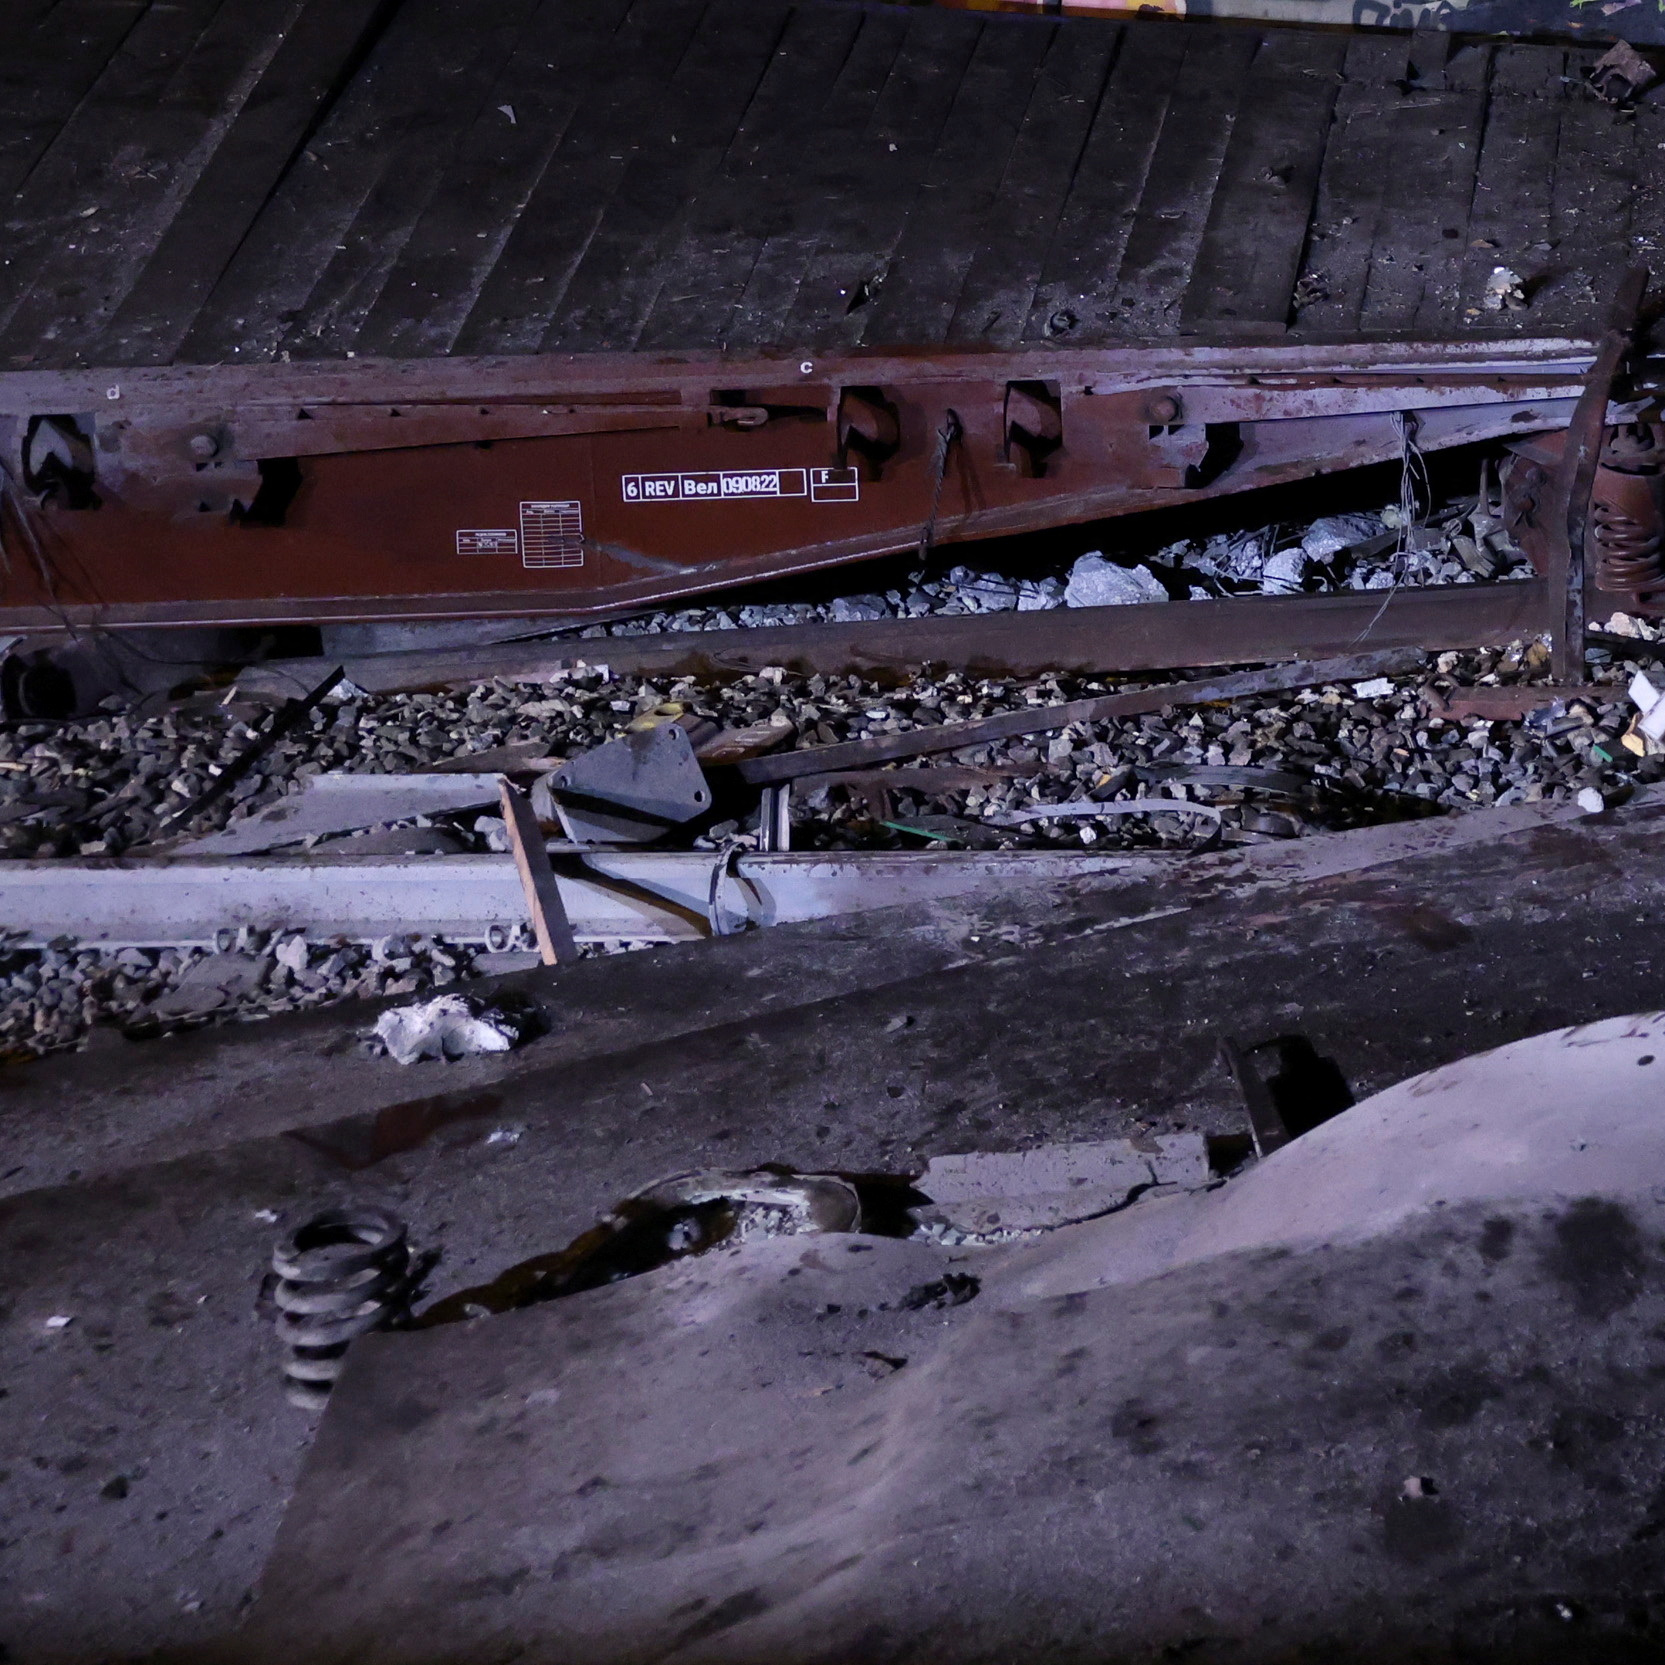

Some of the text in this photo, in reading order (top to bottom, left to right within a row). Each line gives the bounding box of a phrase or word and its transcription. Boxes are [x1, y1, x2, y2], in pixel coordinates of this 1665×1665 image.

[626, 481, 638, 497] 6
[645, 480, 675, 496] REV
[722, 474, 778, 494] 090822
